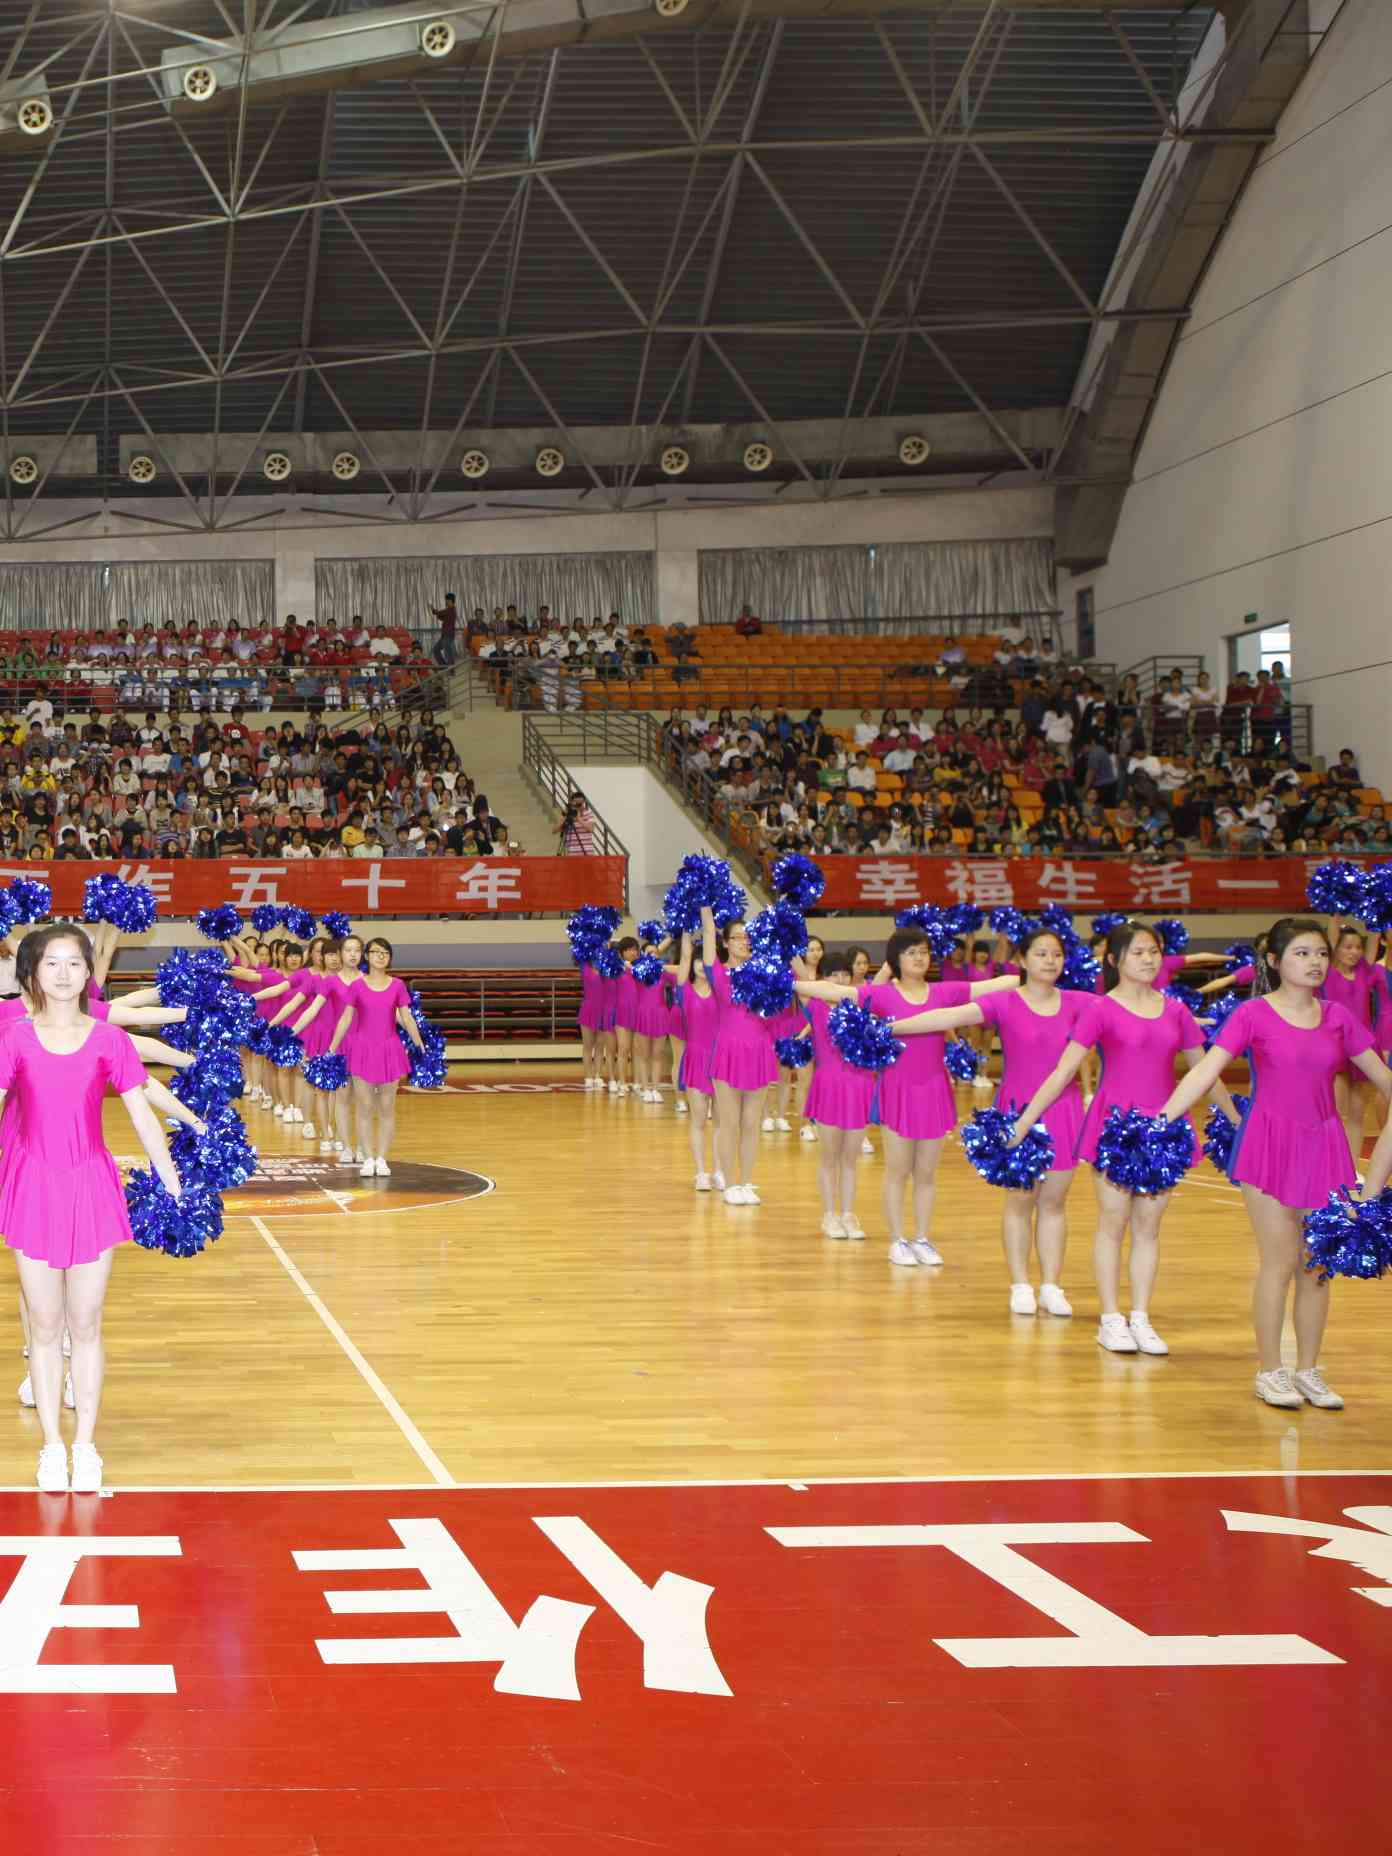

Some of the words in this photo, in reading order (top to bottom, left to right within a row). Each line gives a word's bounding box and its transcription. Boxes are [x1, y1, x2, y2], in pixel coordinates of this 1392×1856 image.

[856, 857, 1366, 906] 幸福生活一
